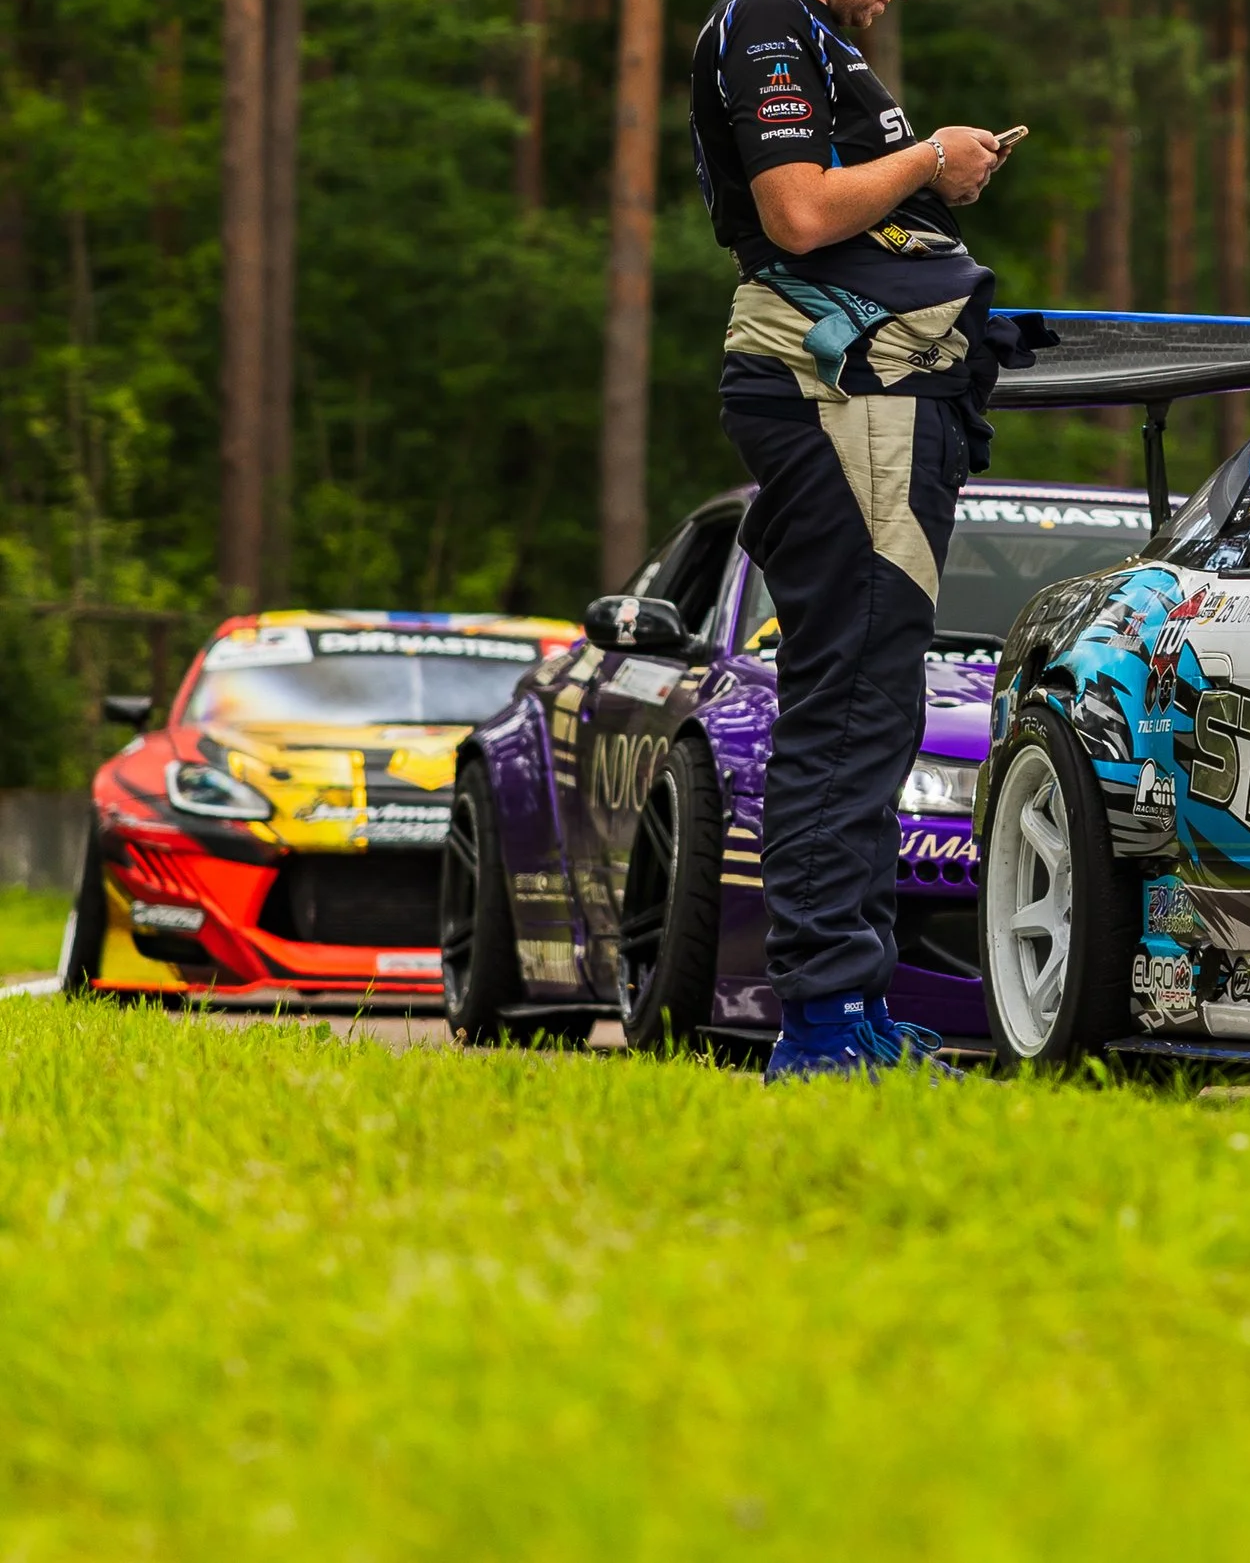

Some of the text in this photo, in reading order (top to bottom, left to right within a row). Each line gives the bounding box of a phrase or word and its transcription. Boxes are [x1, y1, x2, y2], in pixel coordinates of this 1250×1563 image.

[761, 127, 814, 140] BRADLEY
[883, 226, 907, 245] OMP
[1133, 960, 1174, 989] EURO
